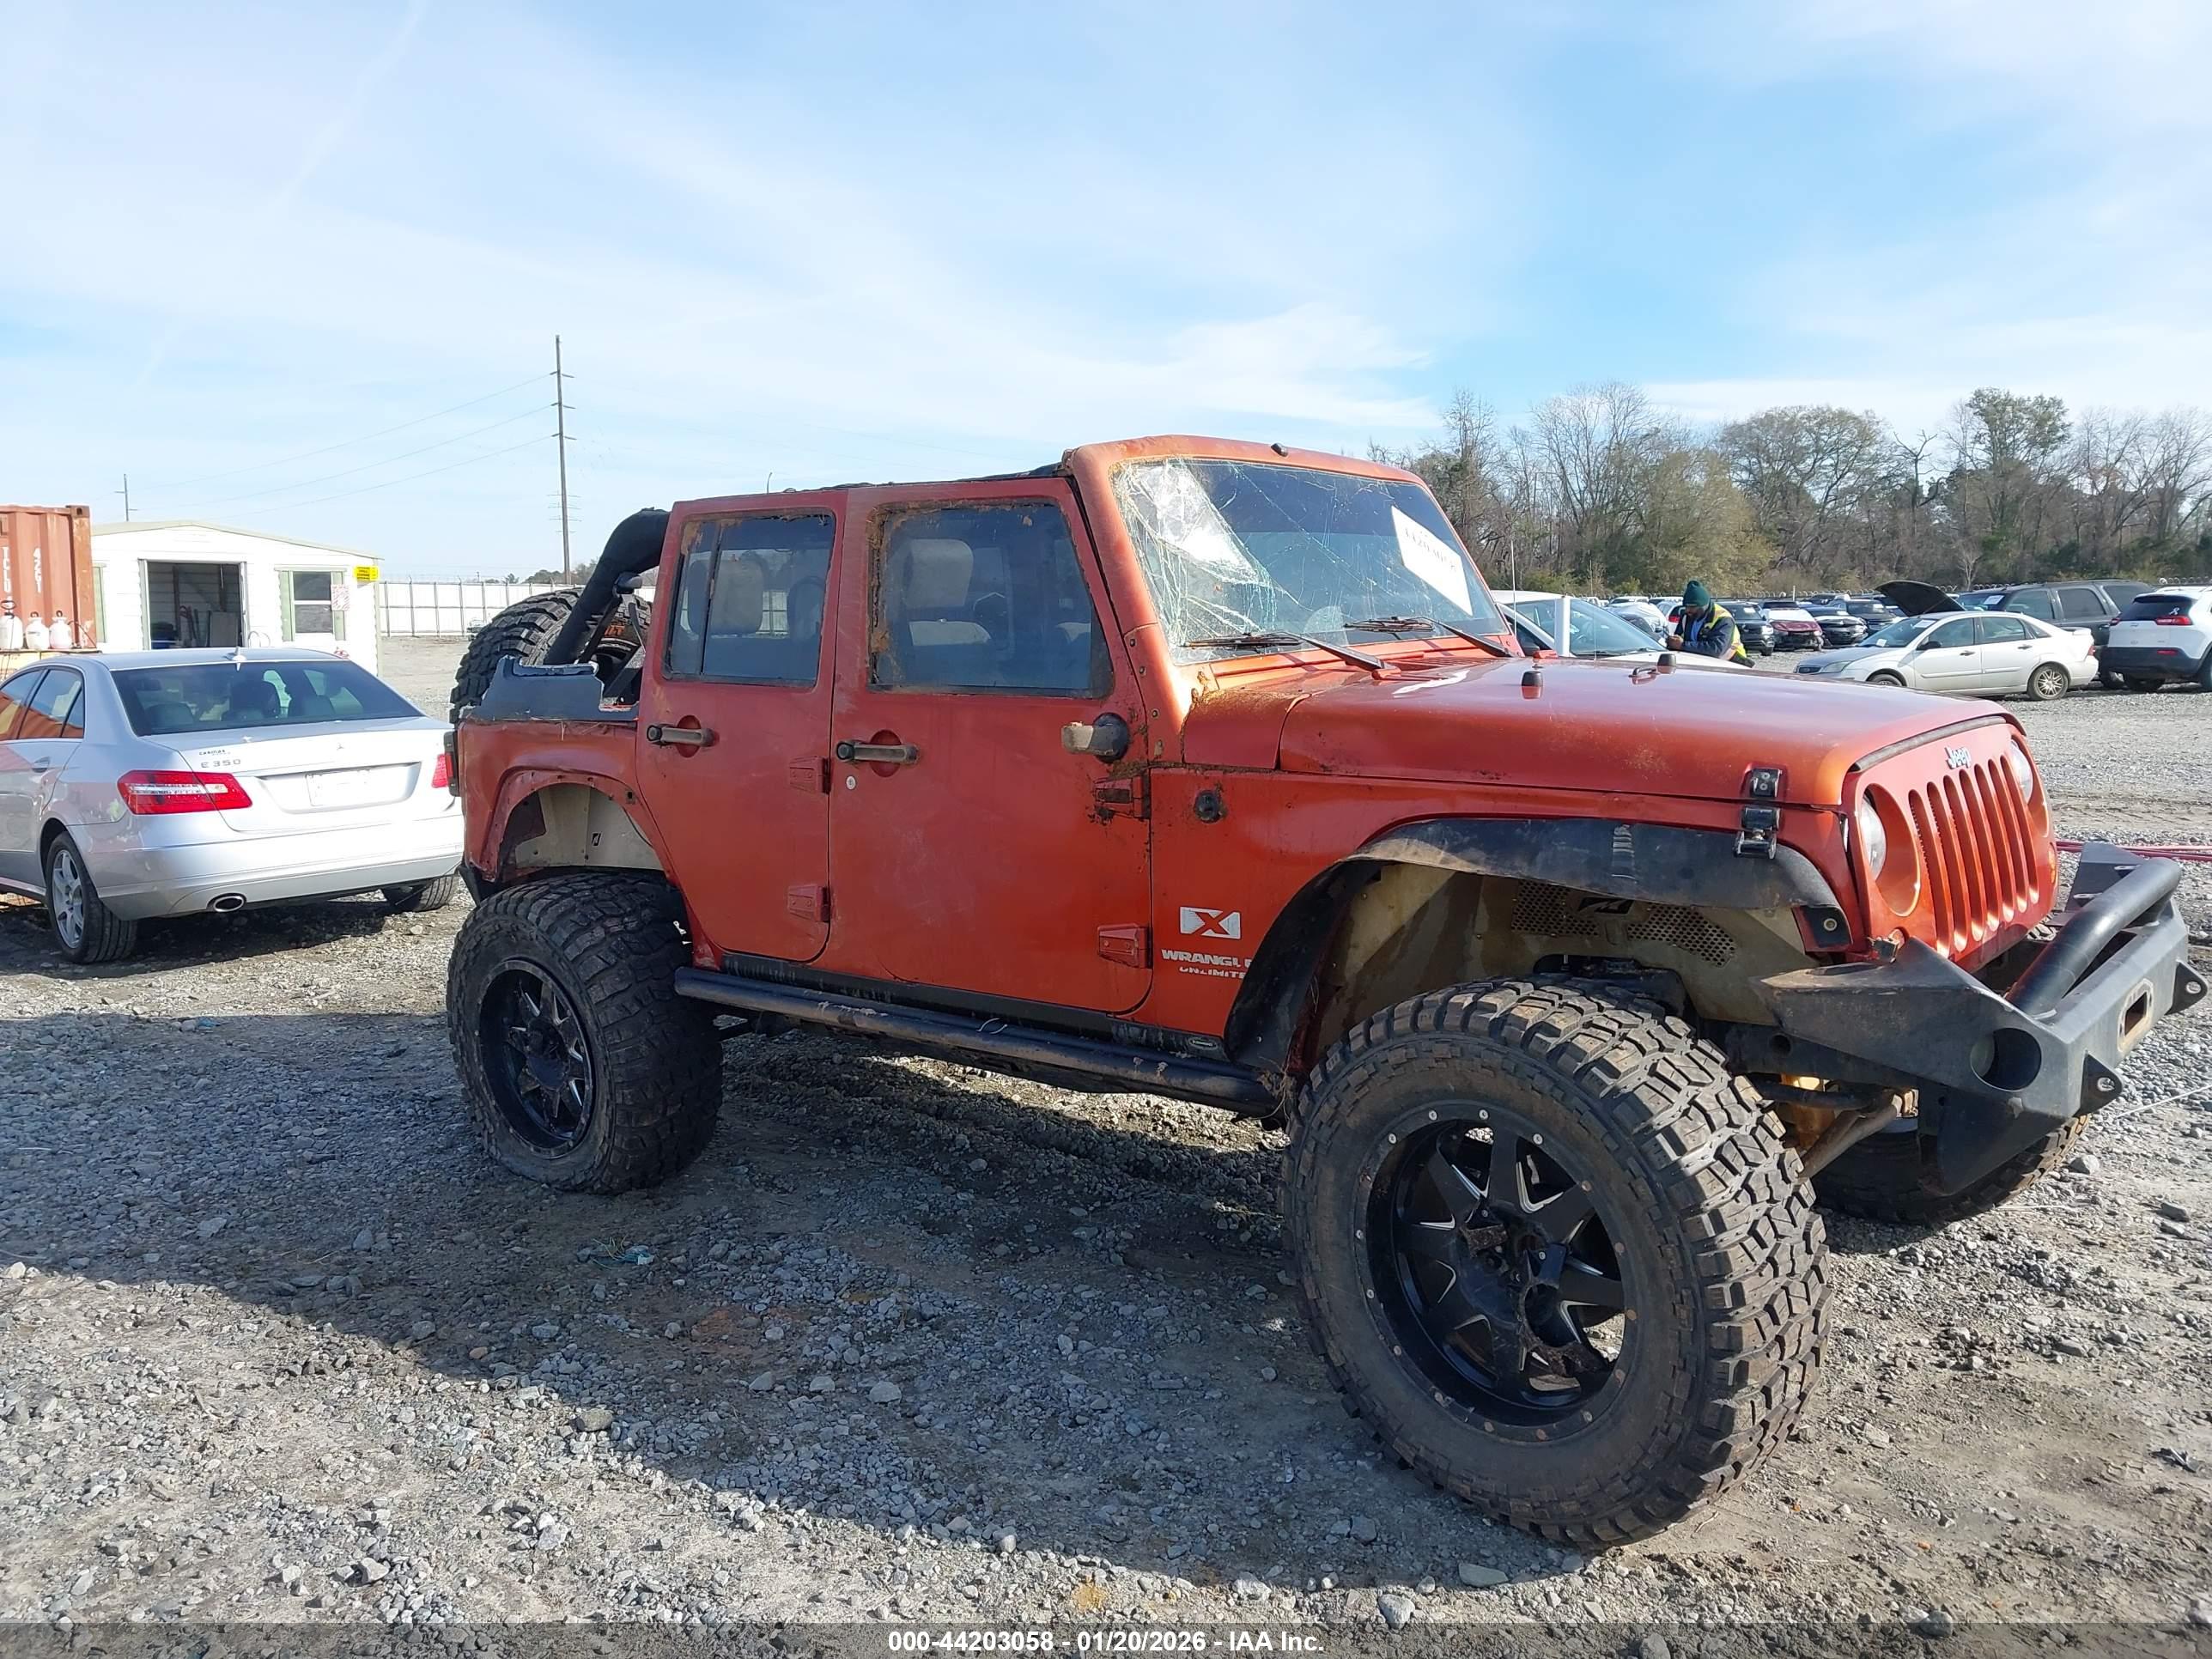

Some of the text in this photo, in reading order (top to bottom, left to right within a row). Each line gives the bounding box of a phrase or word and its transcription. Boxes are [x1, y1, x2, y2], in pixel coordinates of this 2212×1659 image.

[212, 758, 241, 768] 350
[1944, 745, 1972, 769] Jeep
[1188, 908, 1237, 939] X
